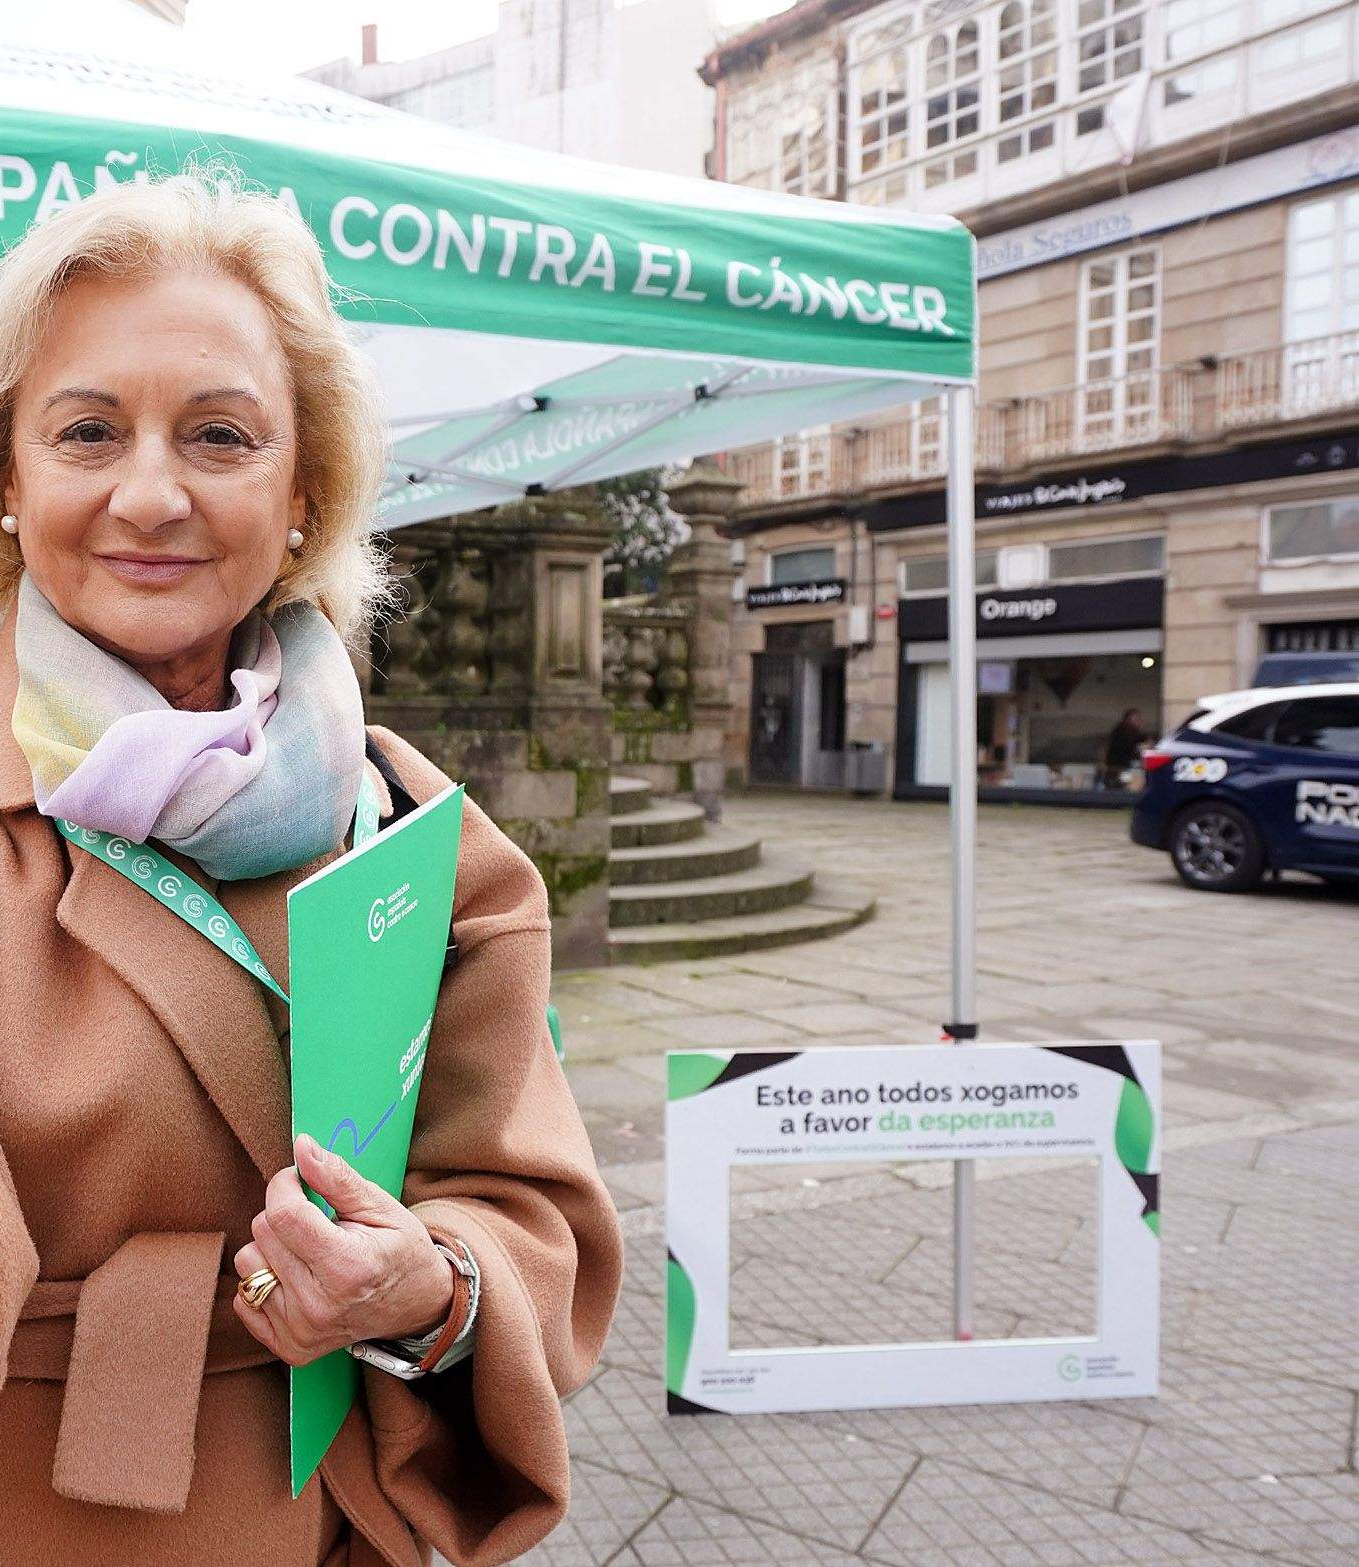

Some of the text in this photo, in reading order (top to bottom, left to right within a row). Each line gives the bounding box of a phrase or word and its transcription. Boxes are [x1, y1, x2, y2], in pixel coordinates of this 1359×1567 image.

[328, 196, 616, 293] CONTRA
[632, 244, 708, 302] EL
[725, 256, 955, 336] CÁNCER
[981, 597, 1057, 620] Orange
[756, 1081, 1080, 1107] Este ano todos xogamos
[780, 1108, 1055, 1135] a favor da esperanza
